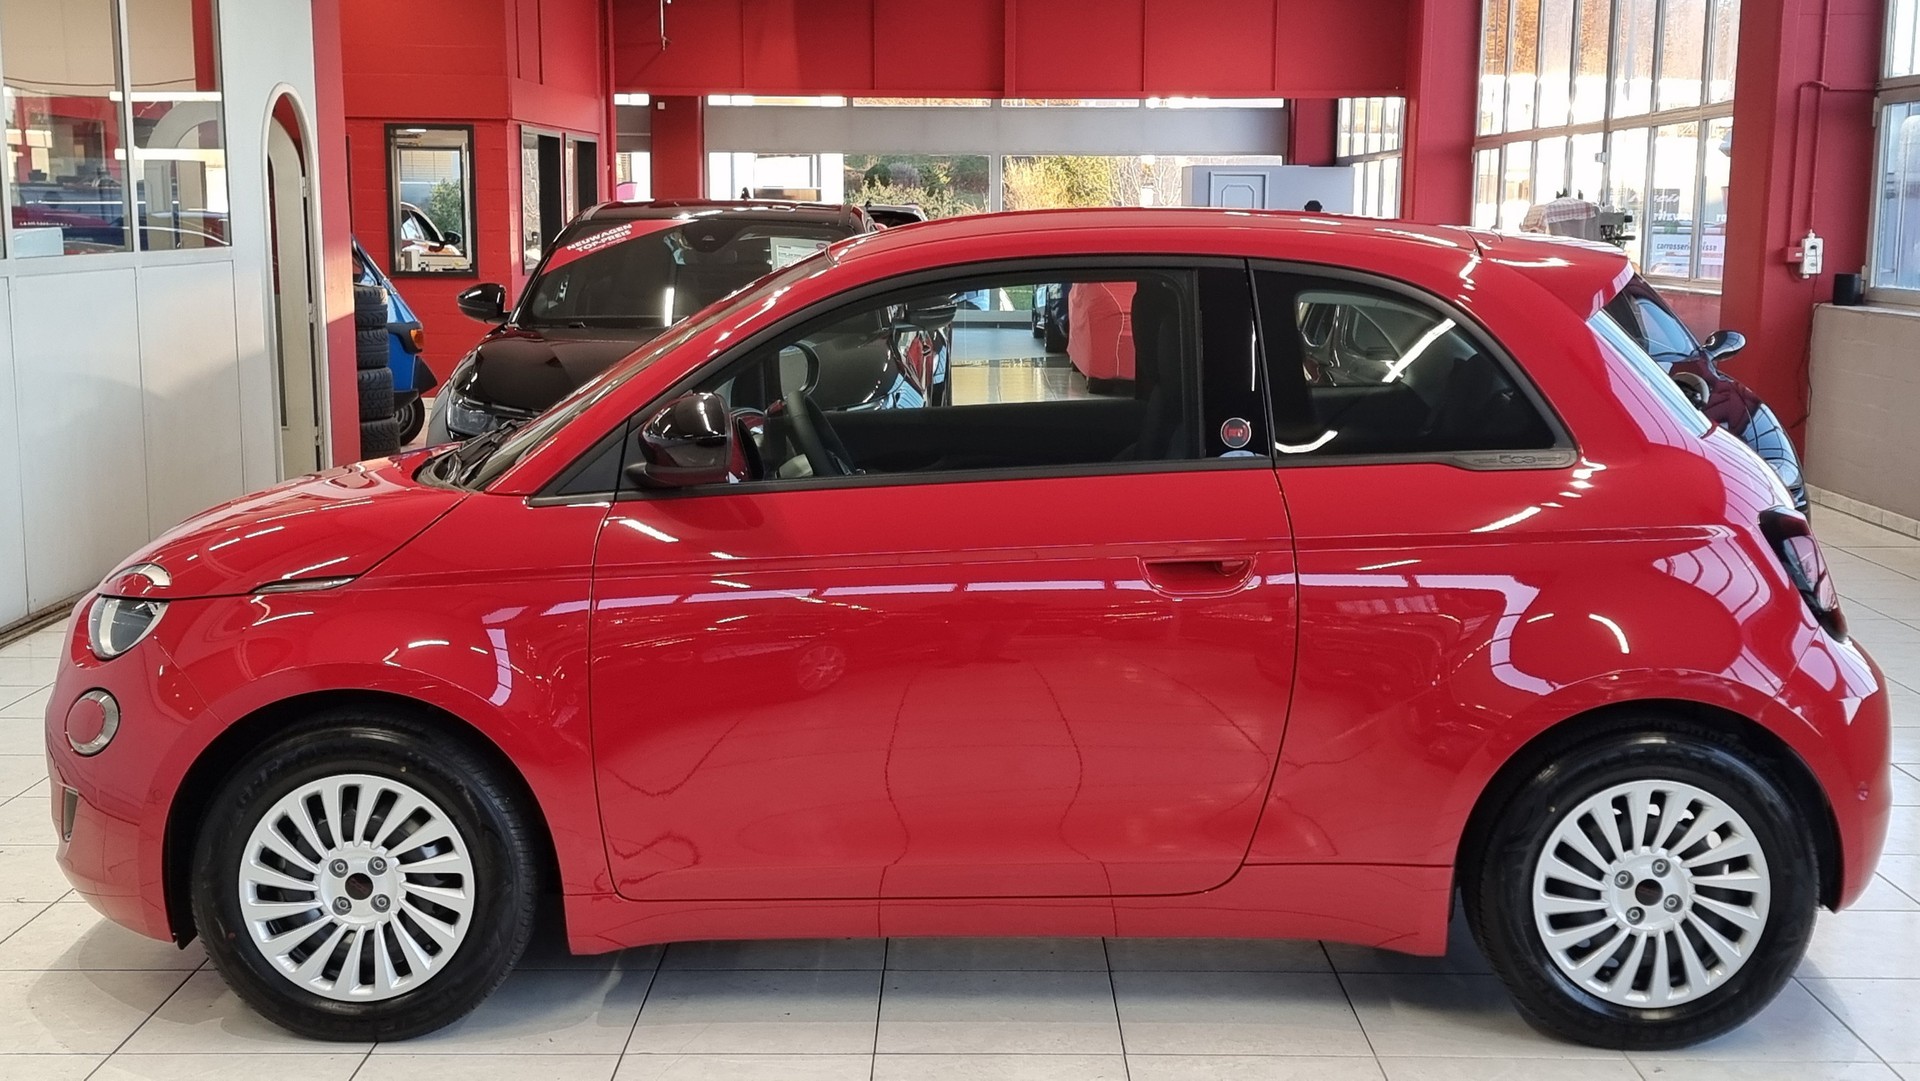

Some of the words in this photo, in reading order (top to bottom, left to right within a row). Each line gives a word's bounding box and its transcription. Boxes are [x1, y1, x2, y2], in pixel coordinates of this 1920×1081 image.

[566, 223, 633, 250] NEUWAGEN
[576, 230, 631, 252] TOP-PREIS
[1656, 241, 1690, 251] carrosseri
